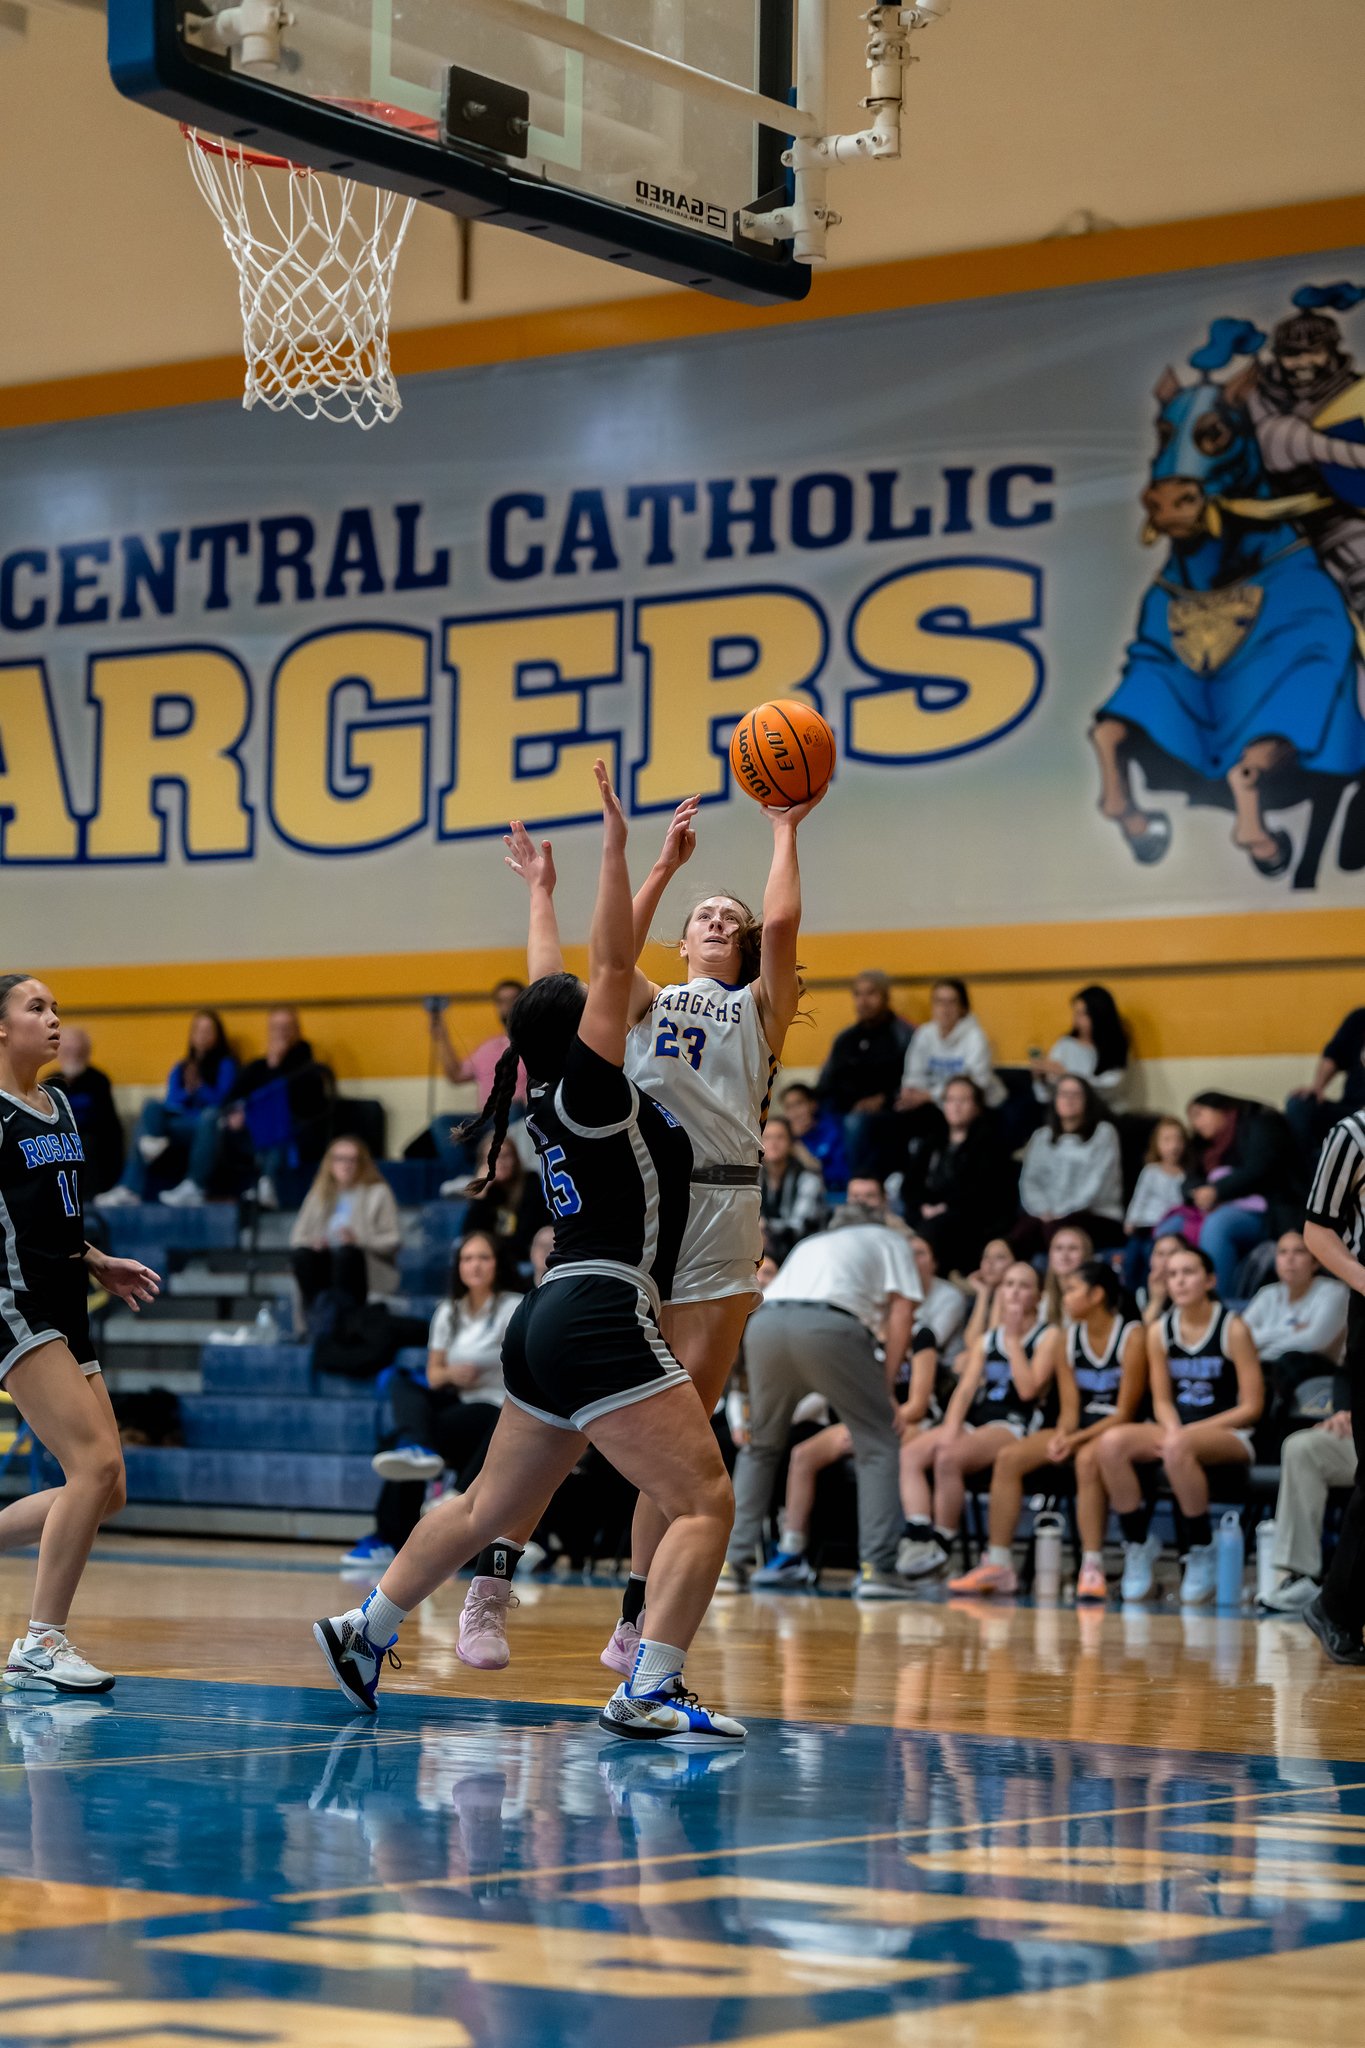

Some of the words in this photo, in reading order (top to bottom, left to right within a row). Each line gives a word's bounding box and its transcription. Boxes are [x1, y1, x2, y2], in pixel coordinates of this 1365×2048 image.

[1, 504, 449, 631] CENTRAL
[487, 464, 1055, 581] CATHOLIC
[739, 728, 771, 798] Wilson
[655, 1016, 706, 1071] 23
